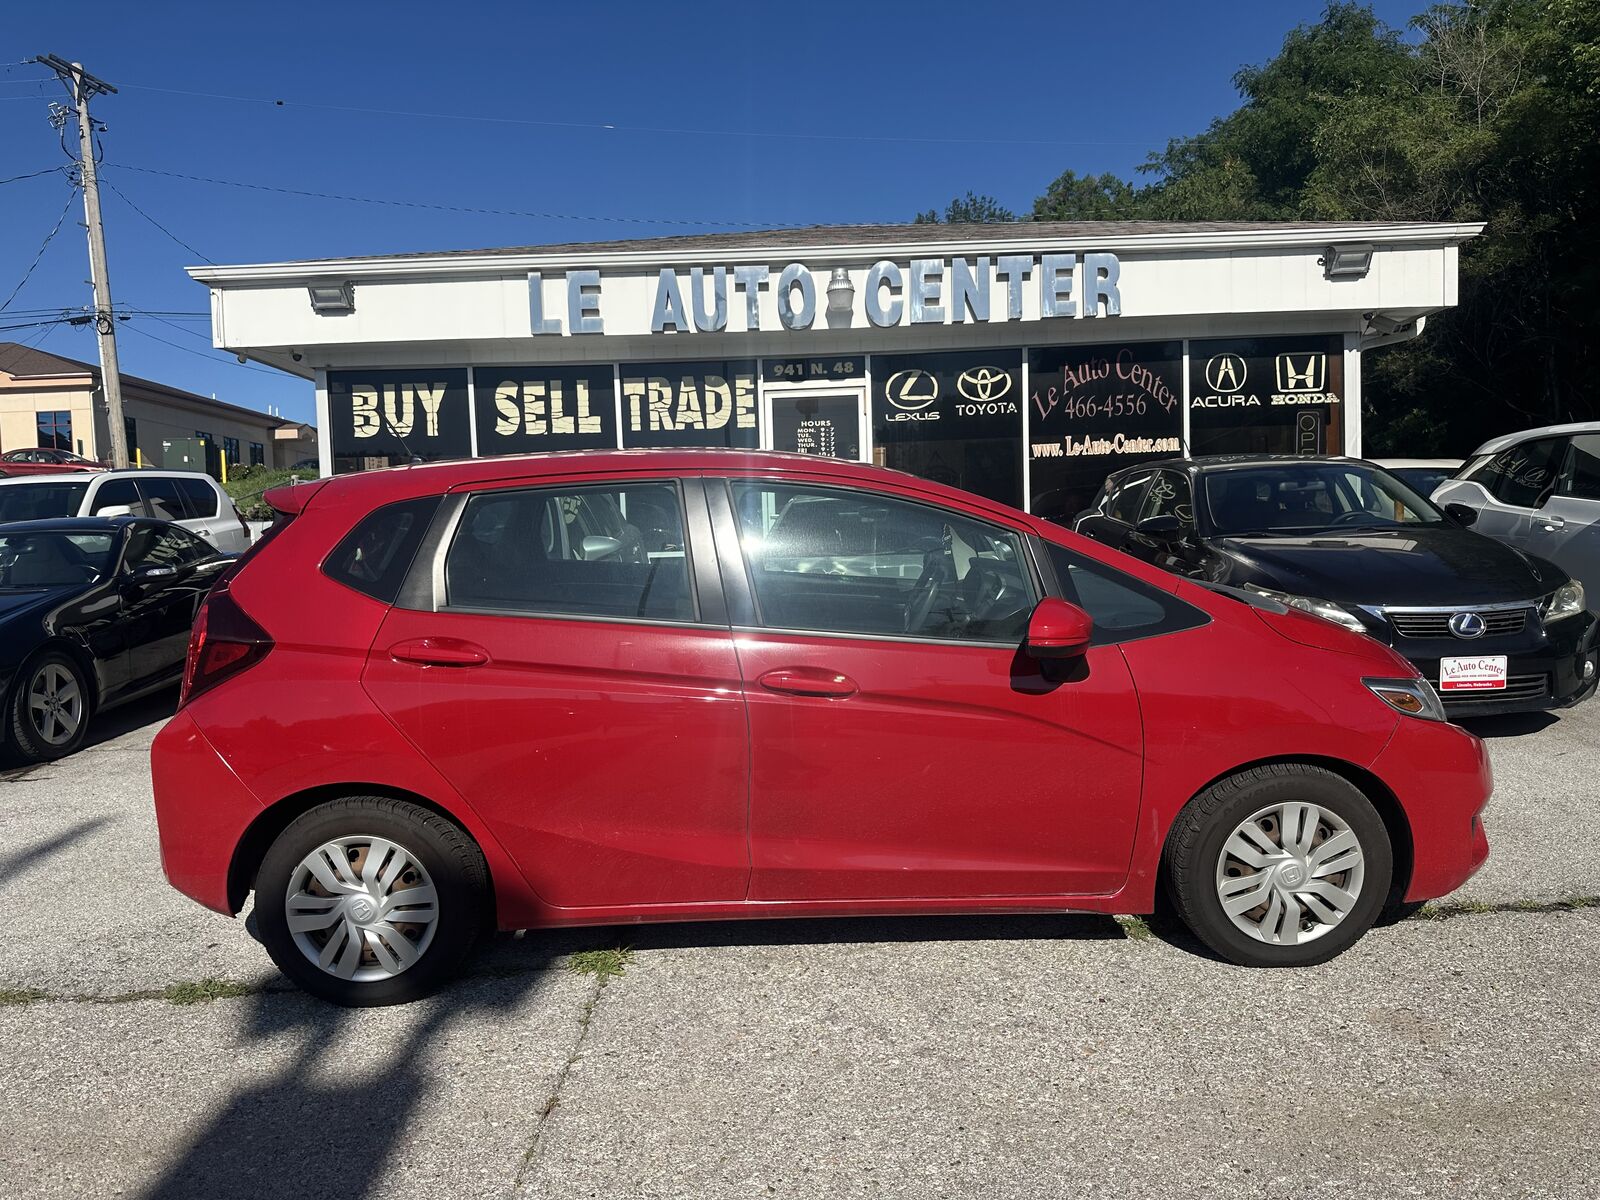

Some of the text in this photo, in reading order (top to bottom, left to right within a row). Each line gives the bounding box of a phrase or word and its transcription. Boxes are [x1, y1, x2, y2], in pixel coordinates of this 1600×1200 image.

[527, 252, 1122, 335] LE AUTO CENTER
[773, 362, 854, 376] 941 N. 48
[1031, 348, 1178, 421] Le Auto Center
[494, 379, 602, 436] SELL
[623, 374, 757, 432] TRADE
[955, 402, 1018, 416] TOYOTA
[1064, 393, 1147, 419] 466-4556
[1190, 394, 1261, 409] ACURA
[1271, 392, 1340, 406] HONDA
[351, 382, 448, 438] BUY
[885, 411, 941, 422] LEXUS
[1444, 660, 1504, 676] Le Auto Center
